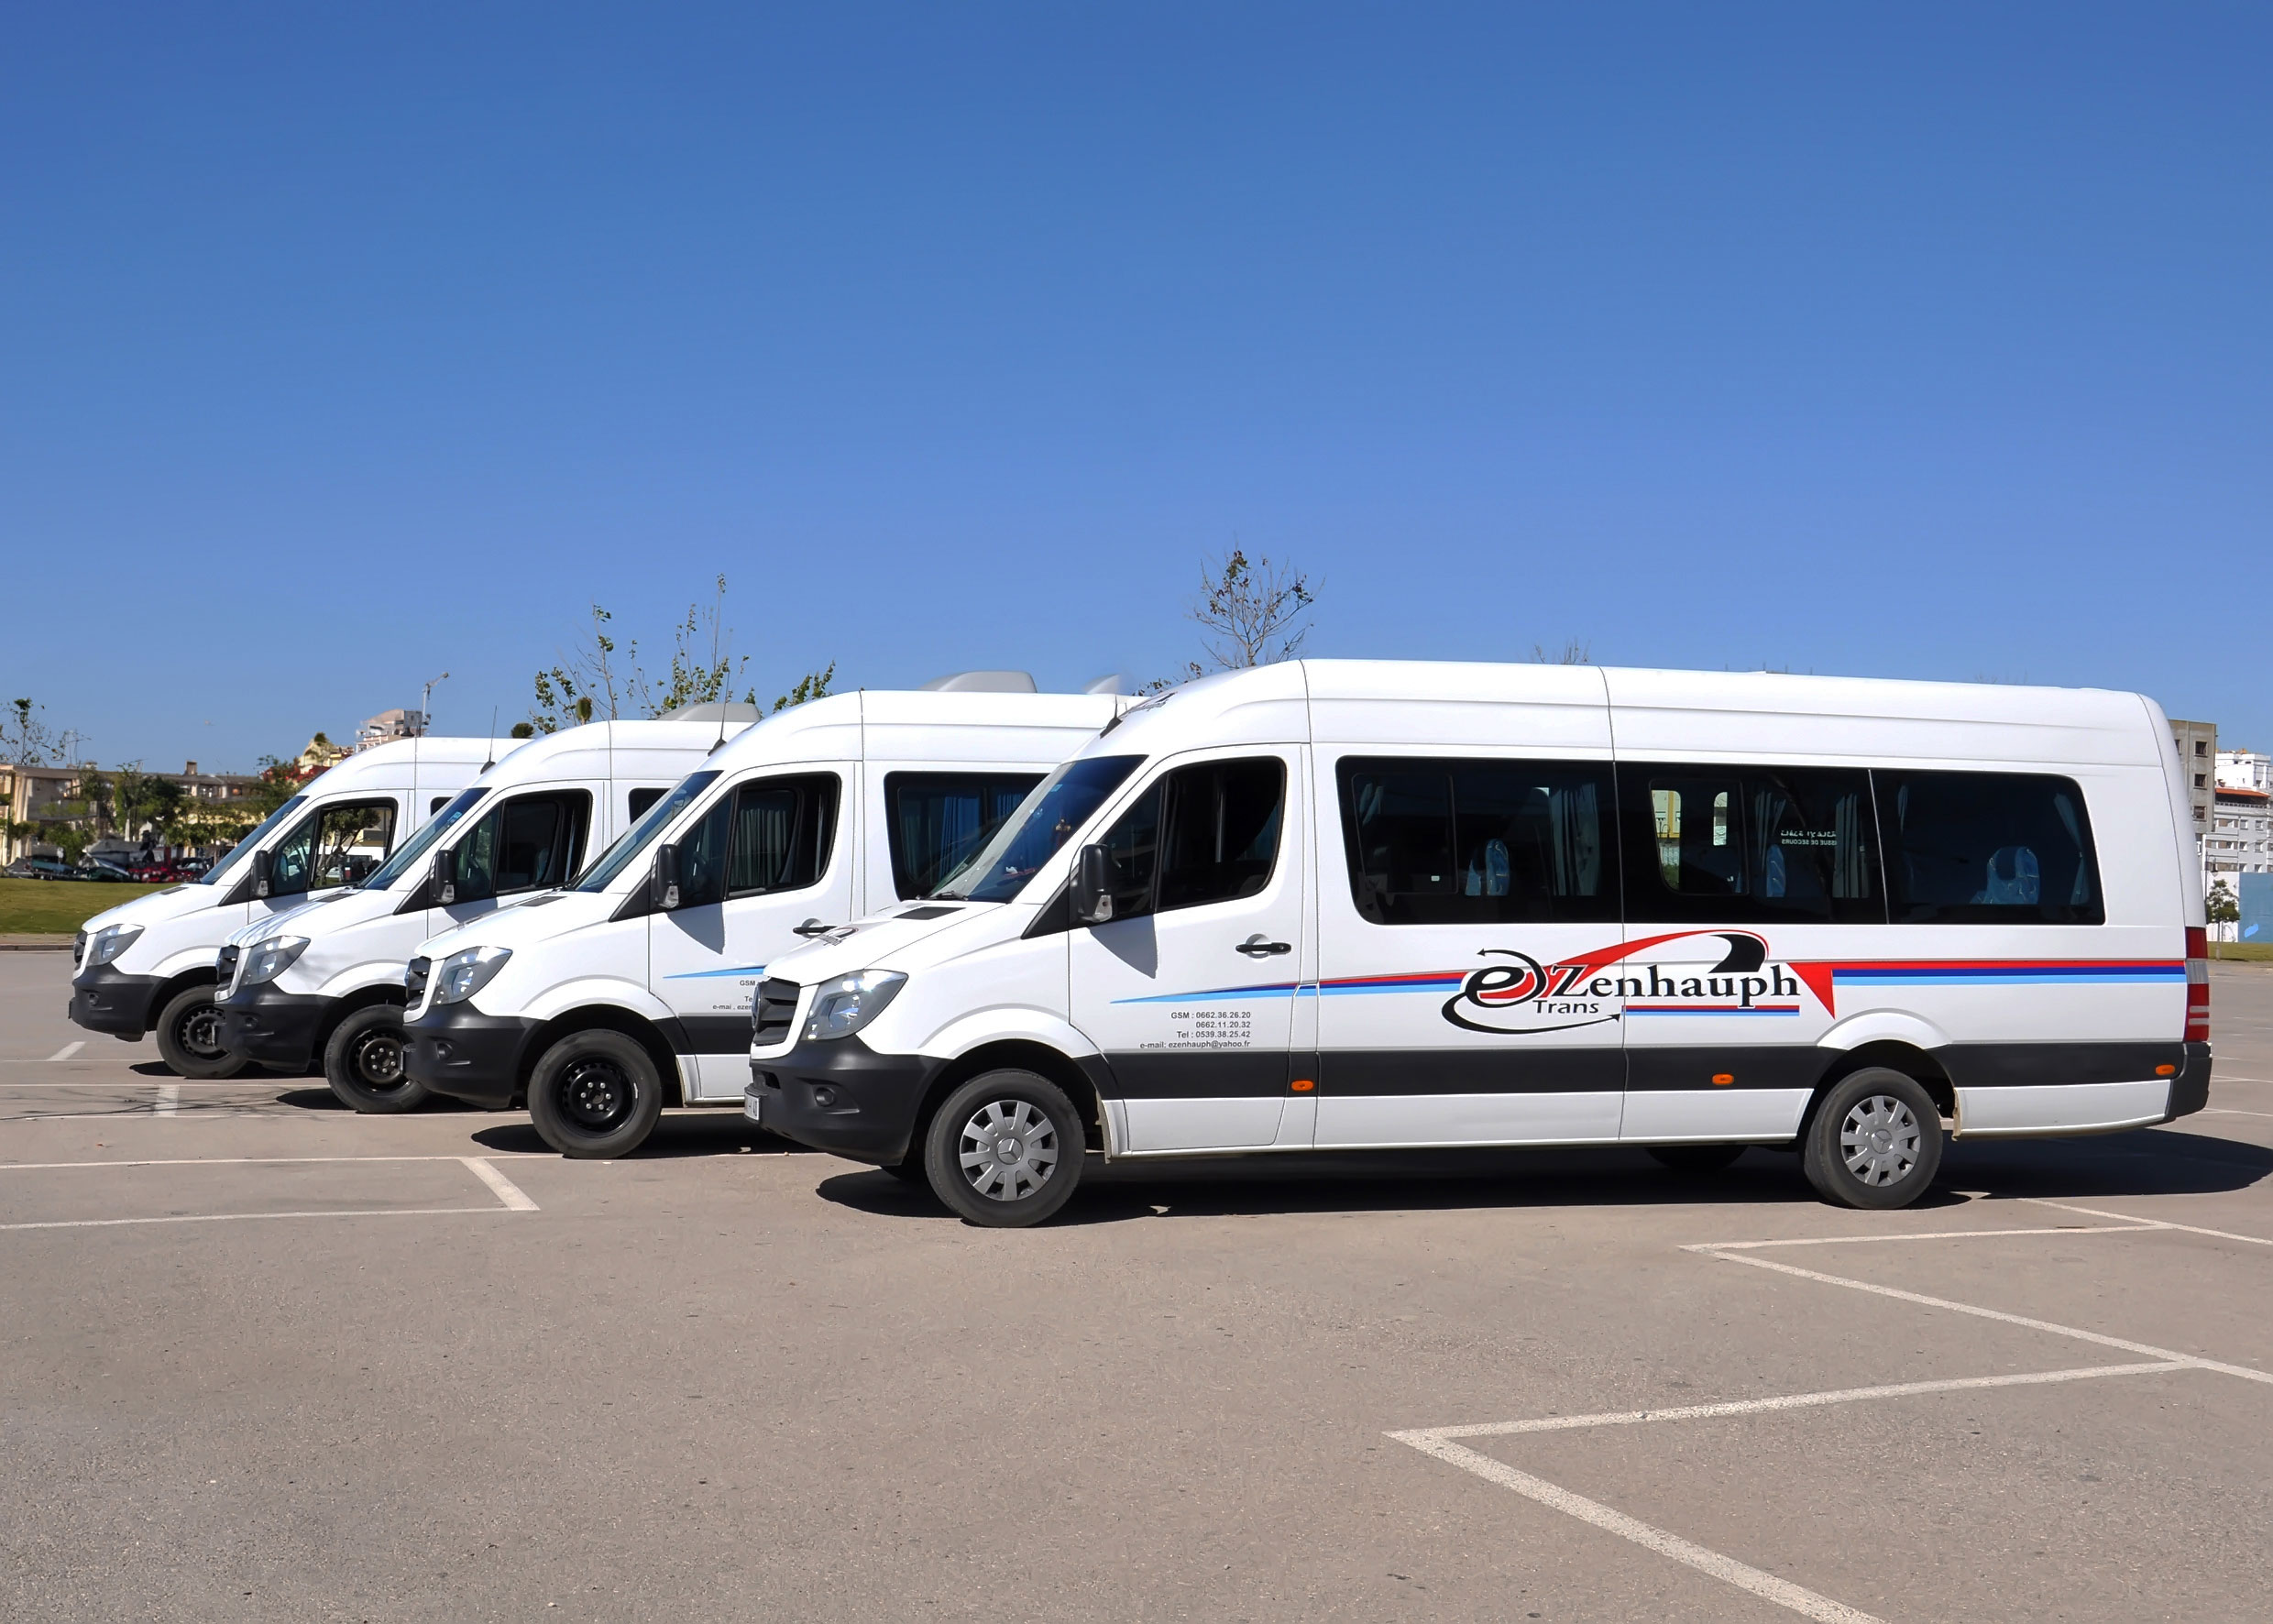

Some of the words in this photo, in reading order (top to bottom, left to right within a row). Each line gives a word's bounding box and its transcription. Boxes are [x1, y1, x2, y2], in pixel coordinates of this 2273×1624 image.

[1532, 999, 1599, 1014] Trans
[1195, 1030, 1251, 1038] 0539.38.25.42
[1168, 1040, 1251, 1048] ezenhauph@yahoo.fr
